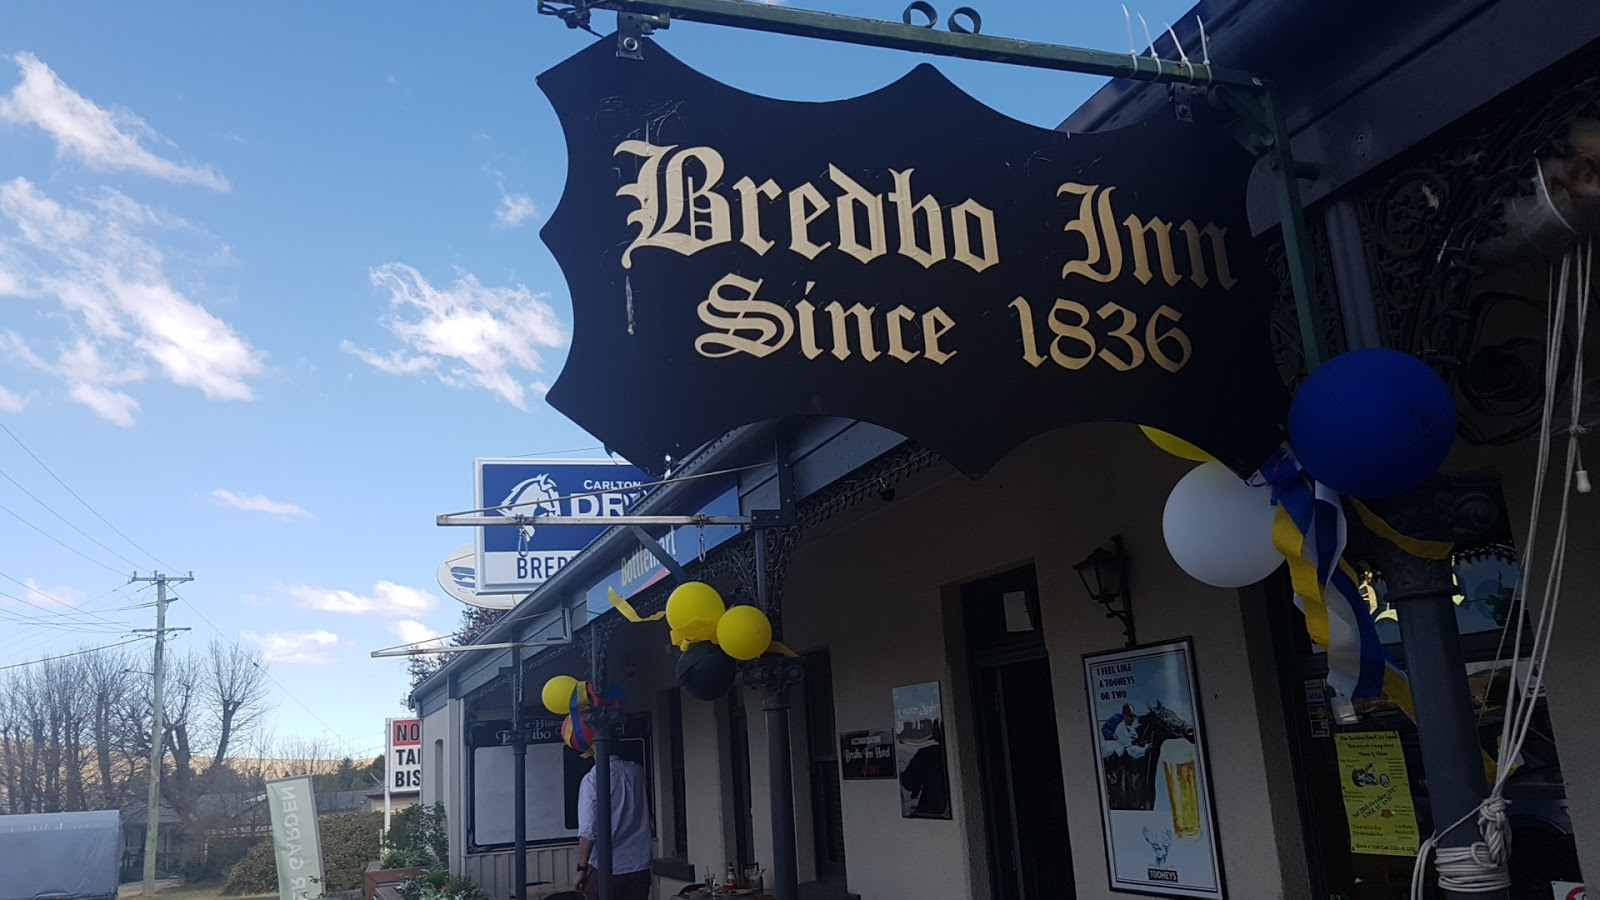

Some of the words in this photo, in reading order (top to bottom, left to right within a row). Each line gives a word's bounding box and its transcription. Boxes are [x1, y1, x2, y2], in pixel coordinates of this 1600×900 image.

[613, 139, 1000, 273] Bredbo
[1056, 182, 1238, 291] Inn
[694, 272, 958, 364] Since
[1008, 295, 1193, 373] 1836
[570, 492, 639, 517] DR
[517, 556, 574, 580] BRED
[1101, 666, 1116, 676] FEEL
[1116, 663, 1132, 673] LIKE
[1099, 679, 1104, 688] A
[1104, 676, 1136, 687] TOOHEYS
[1100, 691, 1111, 701] OR
[1111, 690, 1128, 700] TWO
[1309, 692, 1323, 700] VISA
[533, 719, 563, 728] Histor
[1148, 869, 1178, 881] TOOHEYS
